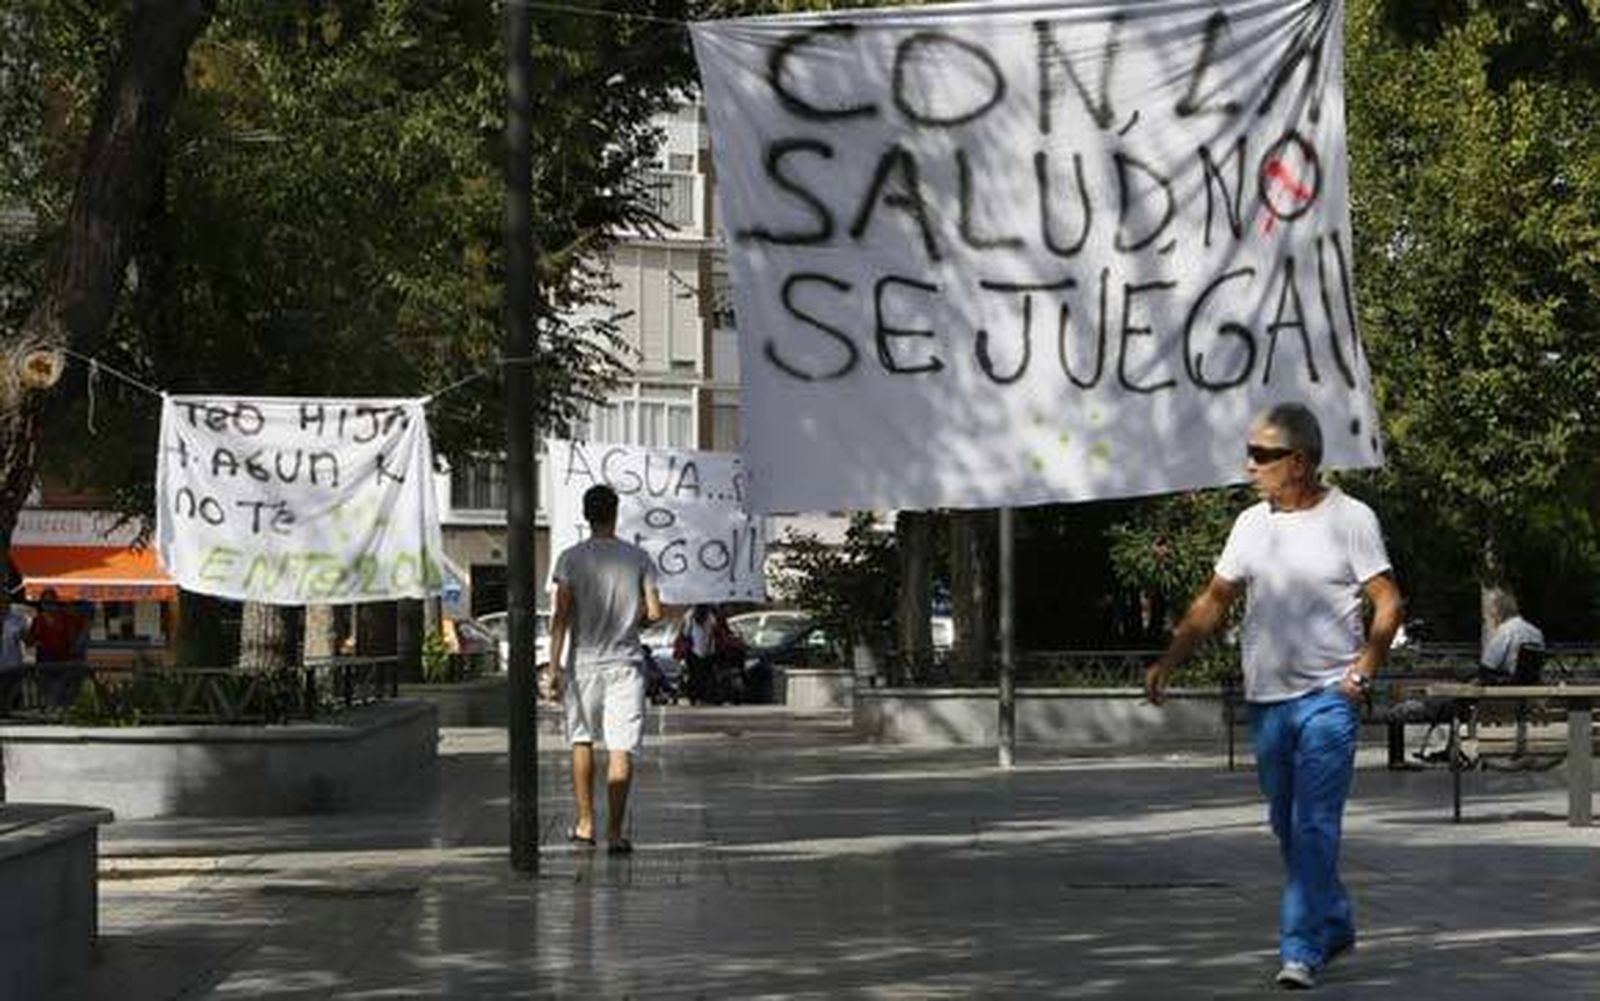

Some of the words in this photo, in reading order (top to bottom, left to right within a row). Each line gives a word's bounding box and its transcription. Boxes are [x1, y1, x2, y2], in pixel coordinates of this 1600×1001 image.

[1198, 129, 1323, 246] NO
[764, 272, 944, 381] SE
[644, 507, 676, 529] O
